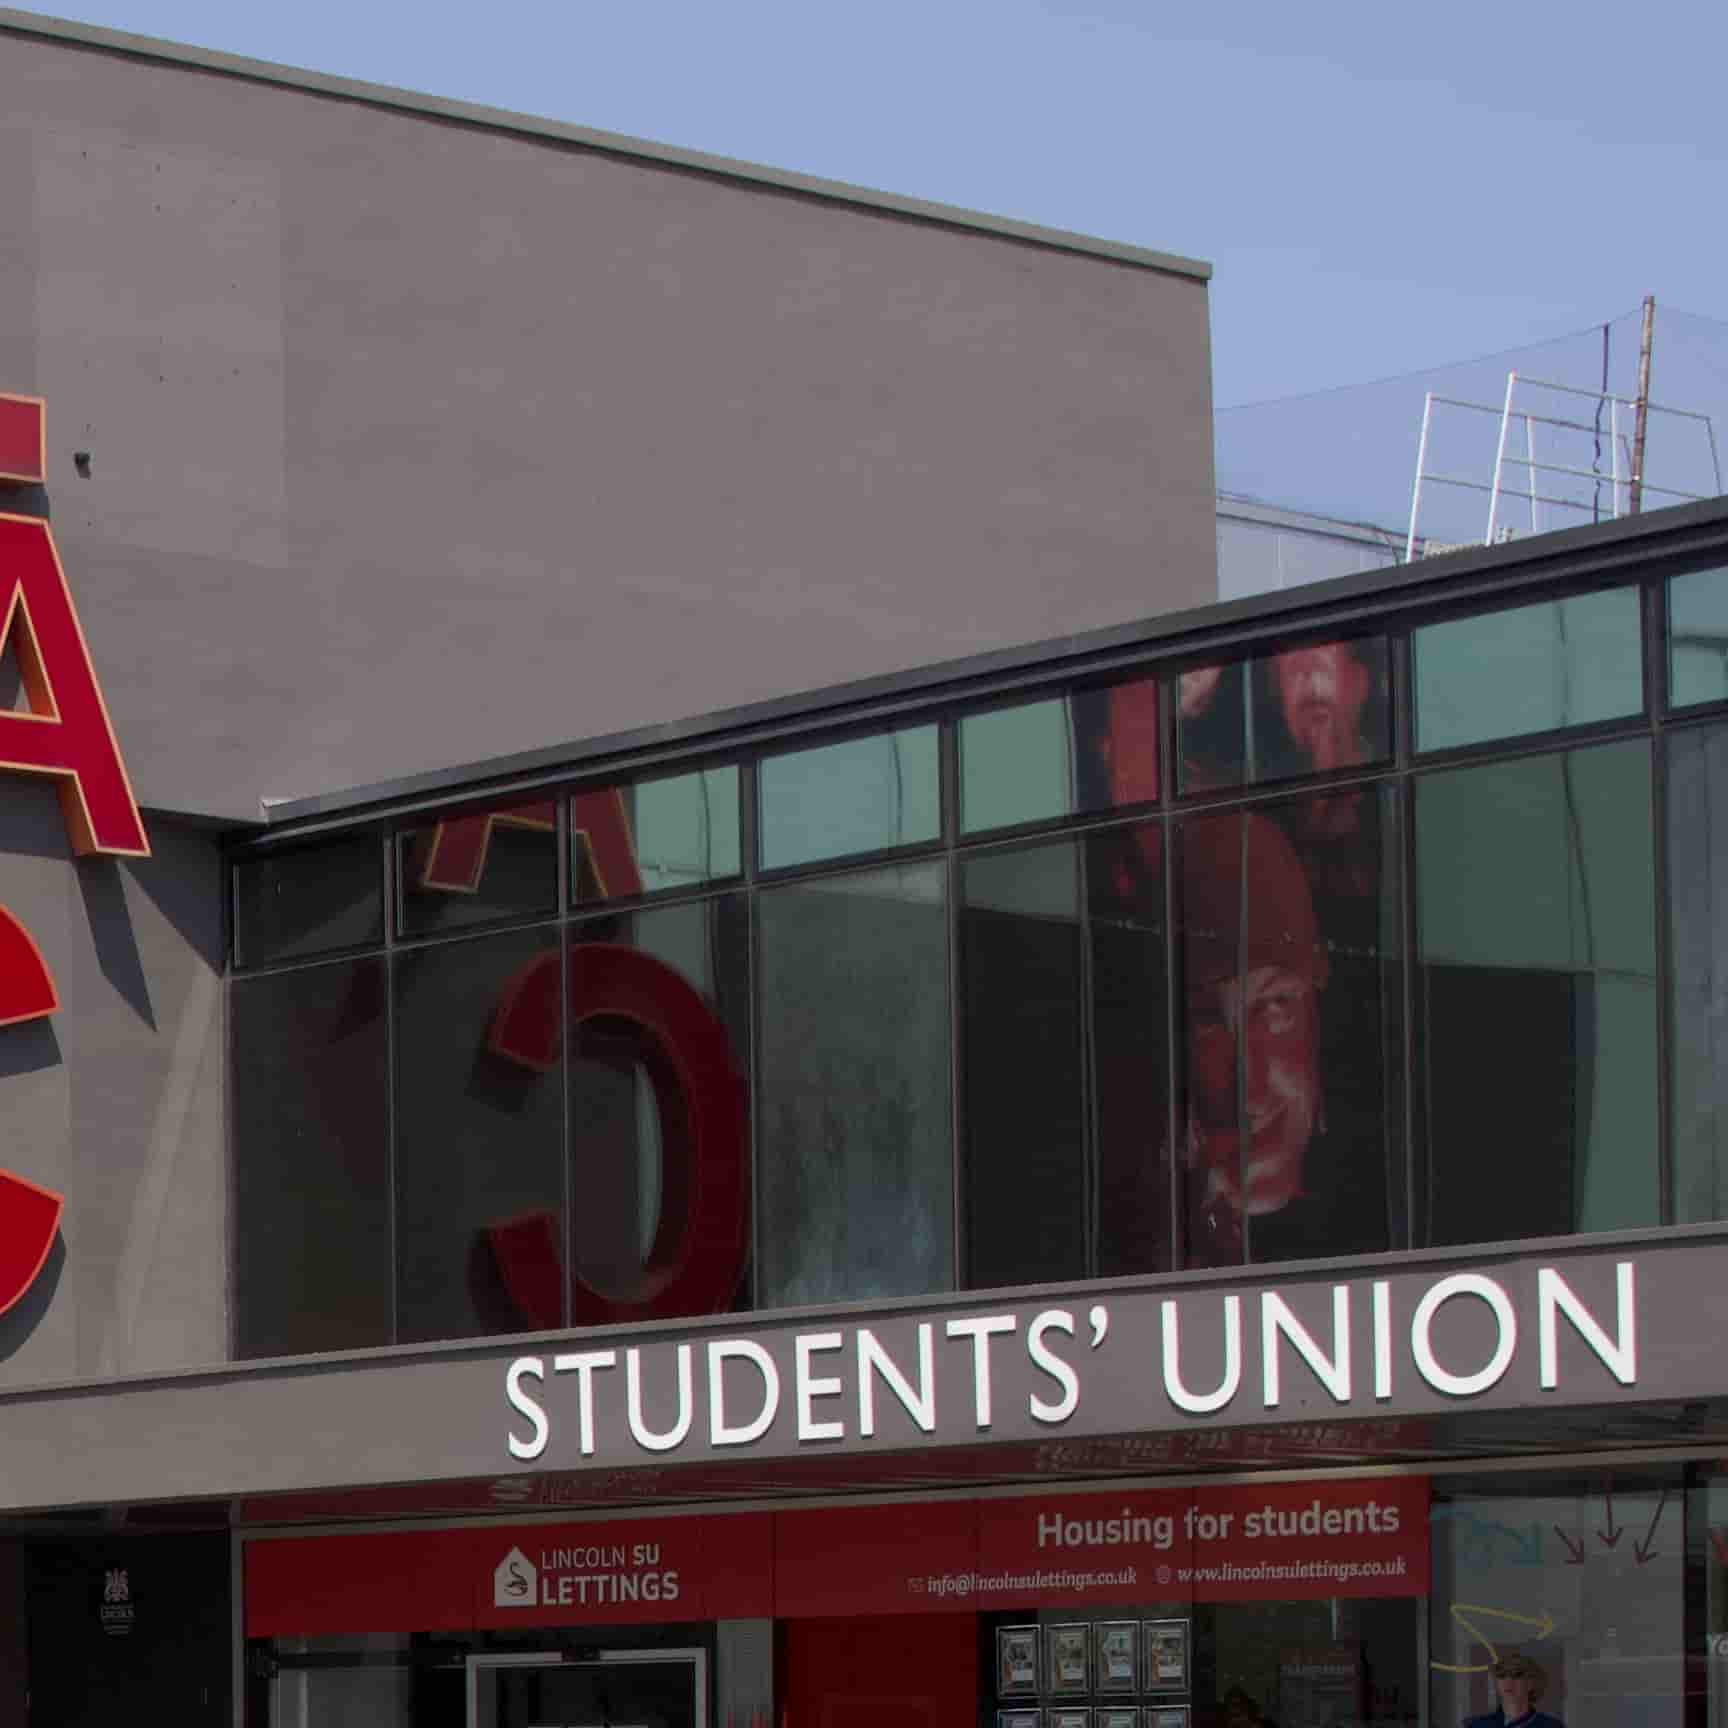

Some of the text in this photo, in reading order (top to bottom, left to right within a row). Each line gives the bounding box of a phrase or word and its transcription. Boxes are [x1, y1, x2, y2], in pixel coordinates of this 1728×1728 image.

[506, 1305, 1109, 1460] STUDENTS'
[1161, 1262, 1637, 1414] UNION
[1038, 1500, 1400, 1549] Housing for students
[542, 1544, 659, 1570] LINCOLN SU
[542, 1571, 679, 1605] LETTINGS
